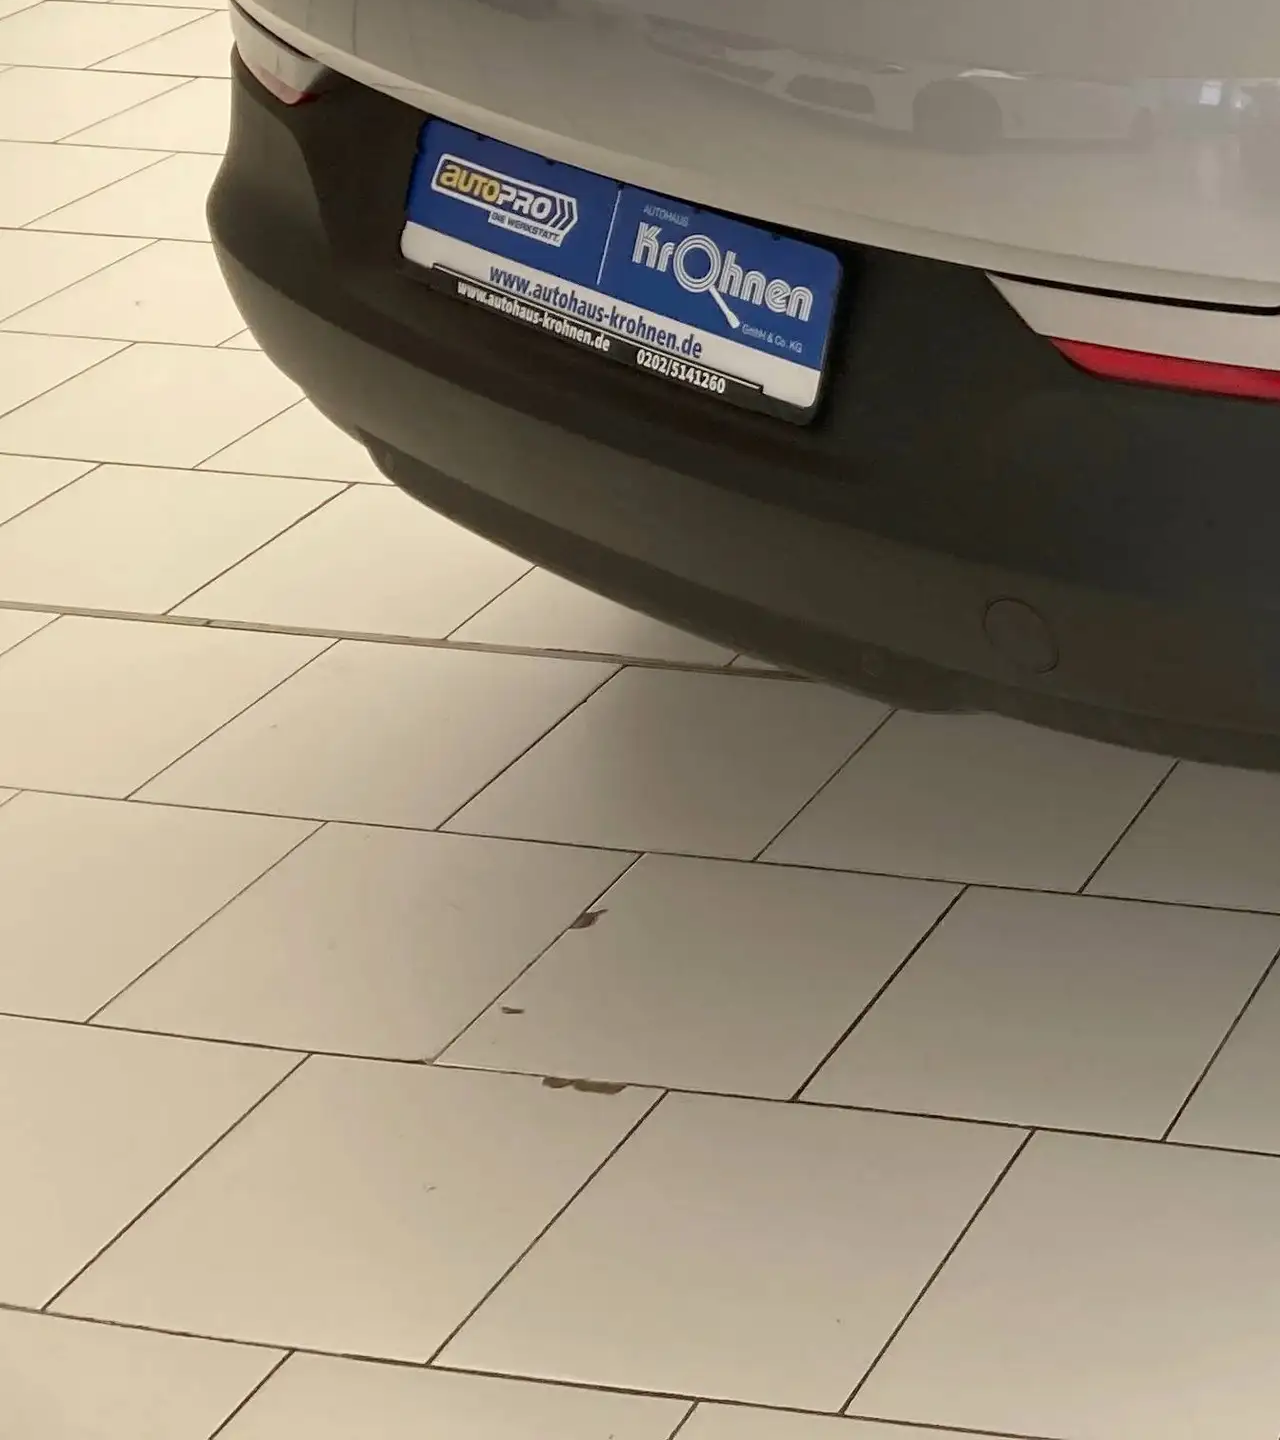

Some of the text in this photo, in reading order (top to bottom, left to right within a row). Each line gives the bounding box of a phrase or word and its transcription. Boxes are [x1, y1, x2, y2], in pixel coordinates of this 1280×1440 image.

[491, 211, 506, 224] DIE
[643, 204, 690, 228] AUTOHAUS
[457, 281, 611, 352] www.autohaus-krohnen.de
[489, 265, 703, 360] www.autohaus-krohnen.de
[789, 340, 803, 354] KG
[636, 347, 727, 395] 0202/5141260
